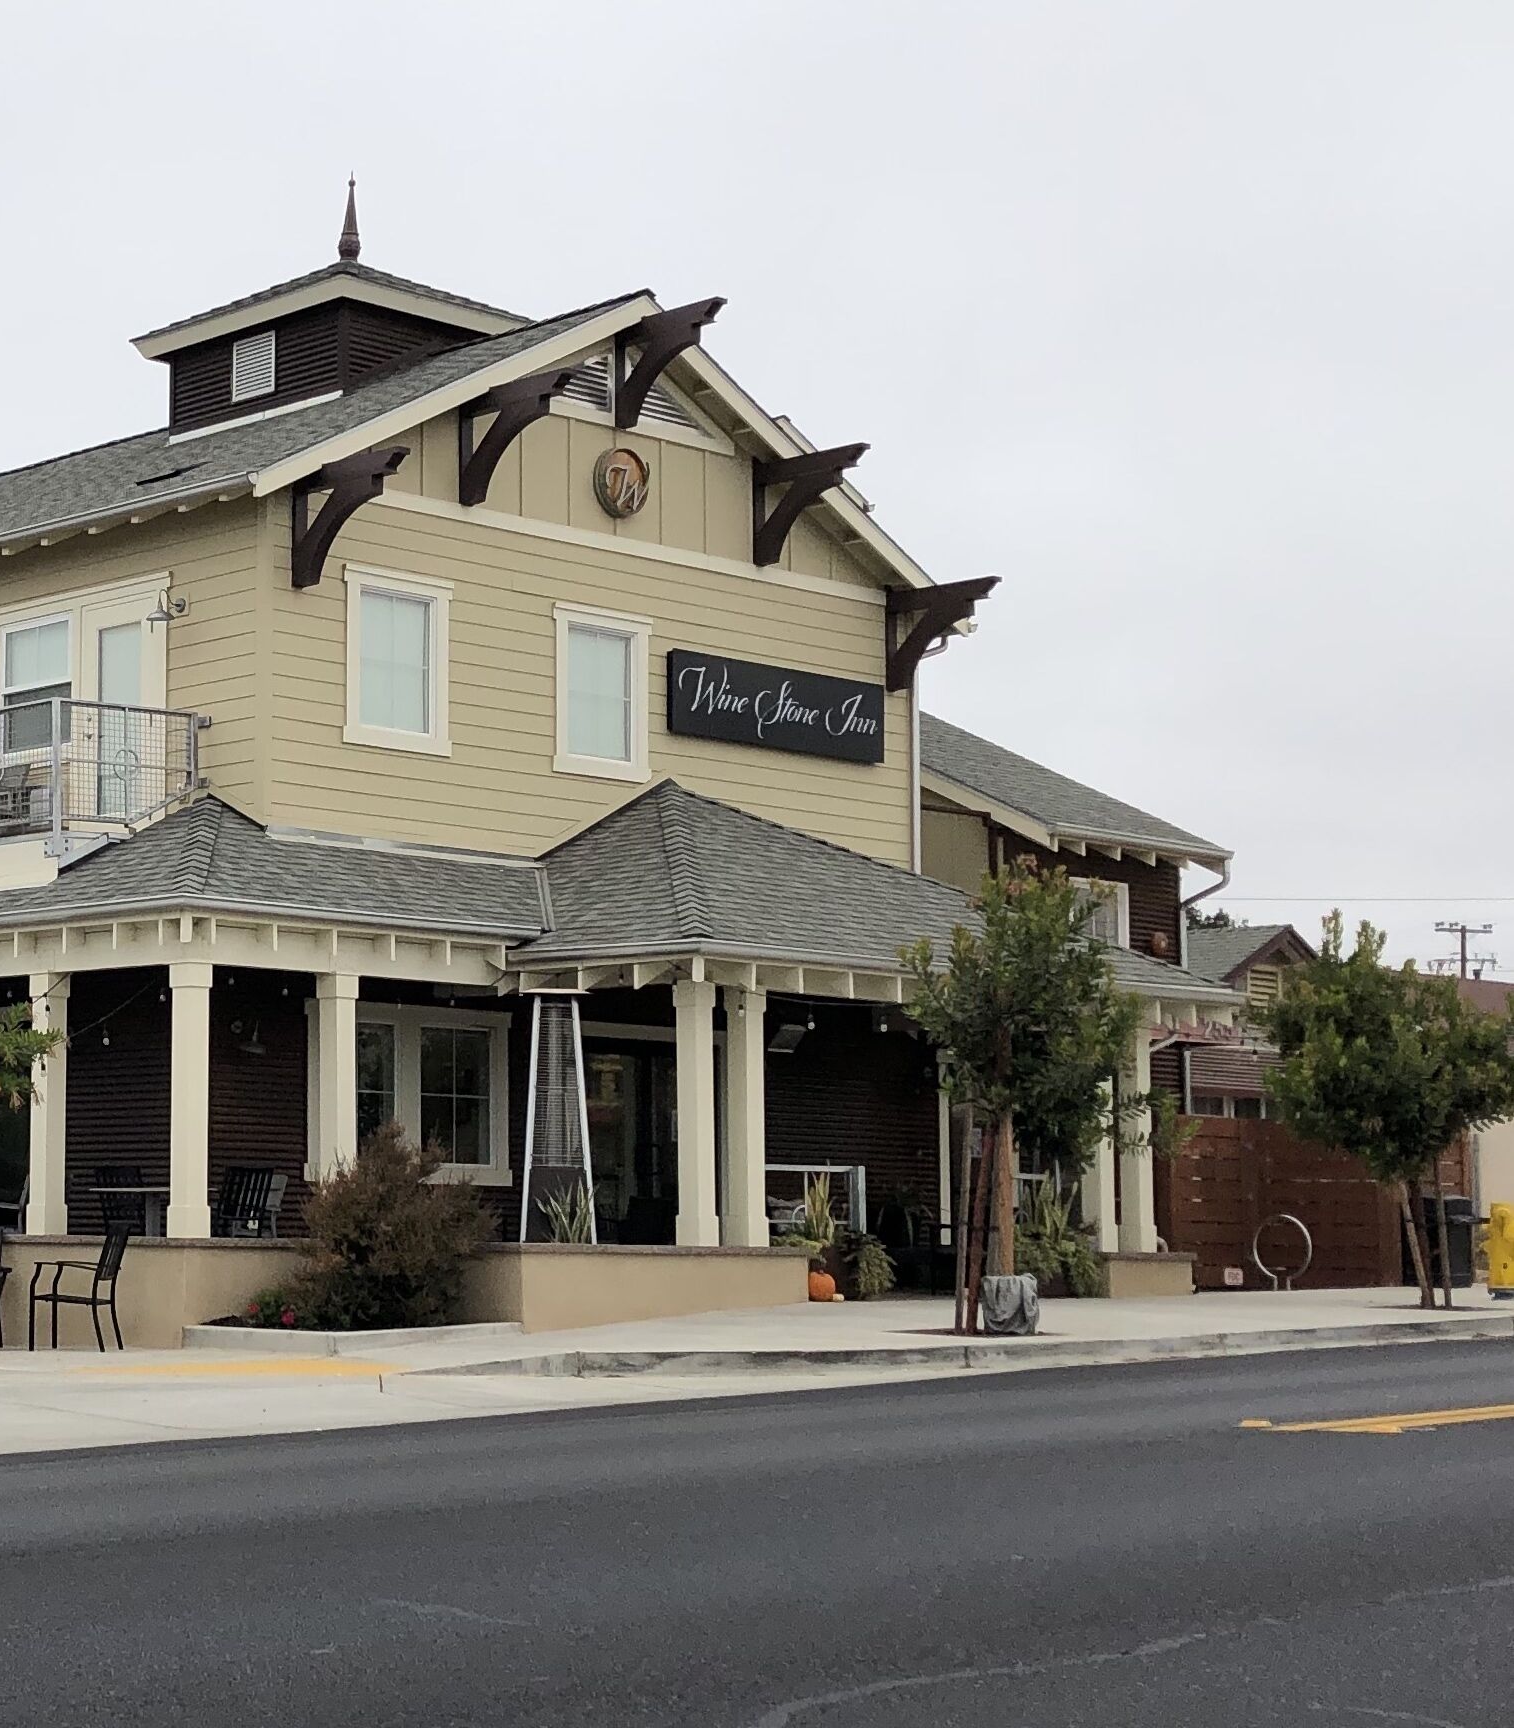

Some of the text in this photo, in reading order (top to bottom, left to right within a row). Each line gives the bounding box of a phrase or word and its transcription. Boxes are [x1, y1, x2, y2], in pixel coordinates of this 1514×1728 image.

[678, 664, 879, 740] Wine Stone Inn
